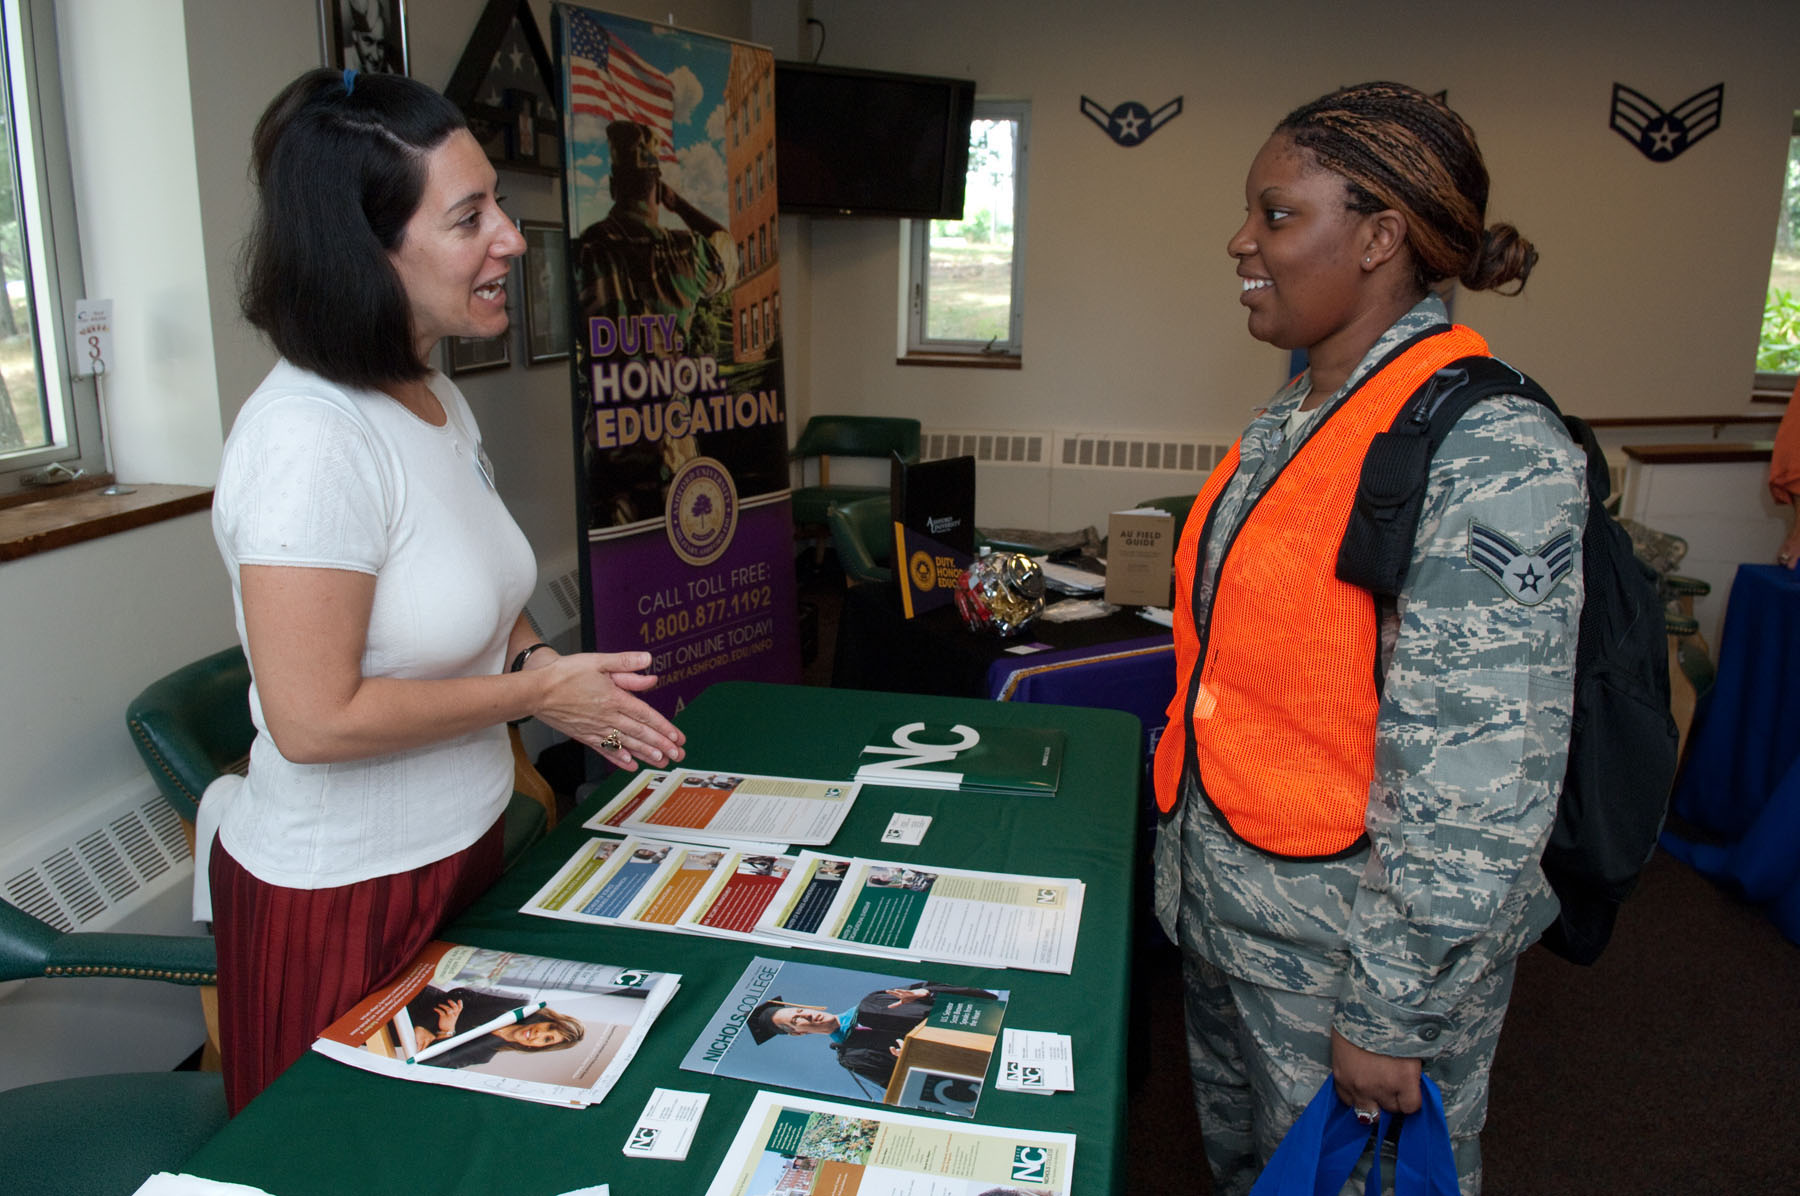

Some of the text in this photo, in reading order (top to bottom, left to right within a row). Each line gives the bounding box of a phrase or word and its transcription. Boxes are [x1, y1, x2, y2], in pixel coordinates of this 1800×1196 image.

[88, 336, 100, 359] 3
[589, 314, 682, 358] DUTY.
[592, 356, 727, 404] HONOR.
[596, 390, 785, 448] EDUCATION.
[1120, 530, 1161, 539] AU FIELD
[638, 561, 771, 615] CALL TOLL FREE:
[640, 585, 772, 645] 1.800.877.1192
[676, 634, 725, 664] ONLINE
[729, 617, 774, 646] TODAY!
[854, 721, 980, 783] NC
[703, 1013, 746, 1063] NICHOLS
[737, 966, 779, 1015] COLLEGE
[1022, 1067, 1041, 1086] NC
[630, 1127, 658, 1150] NC
[1012, 1147, 1047, 1183] NC
